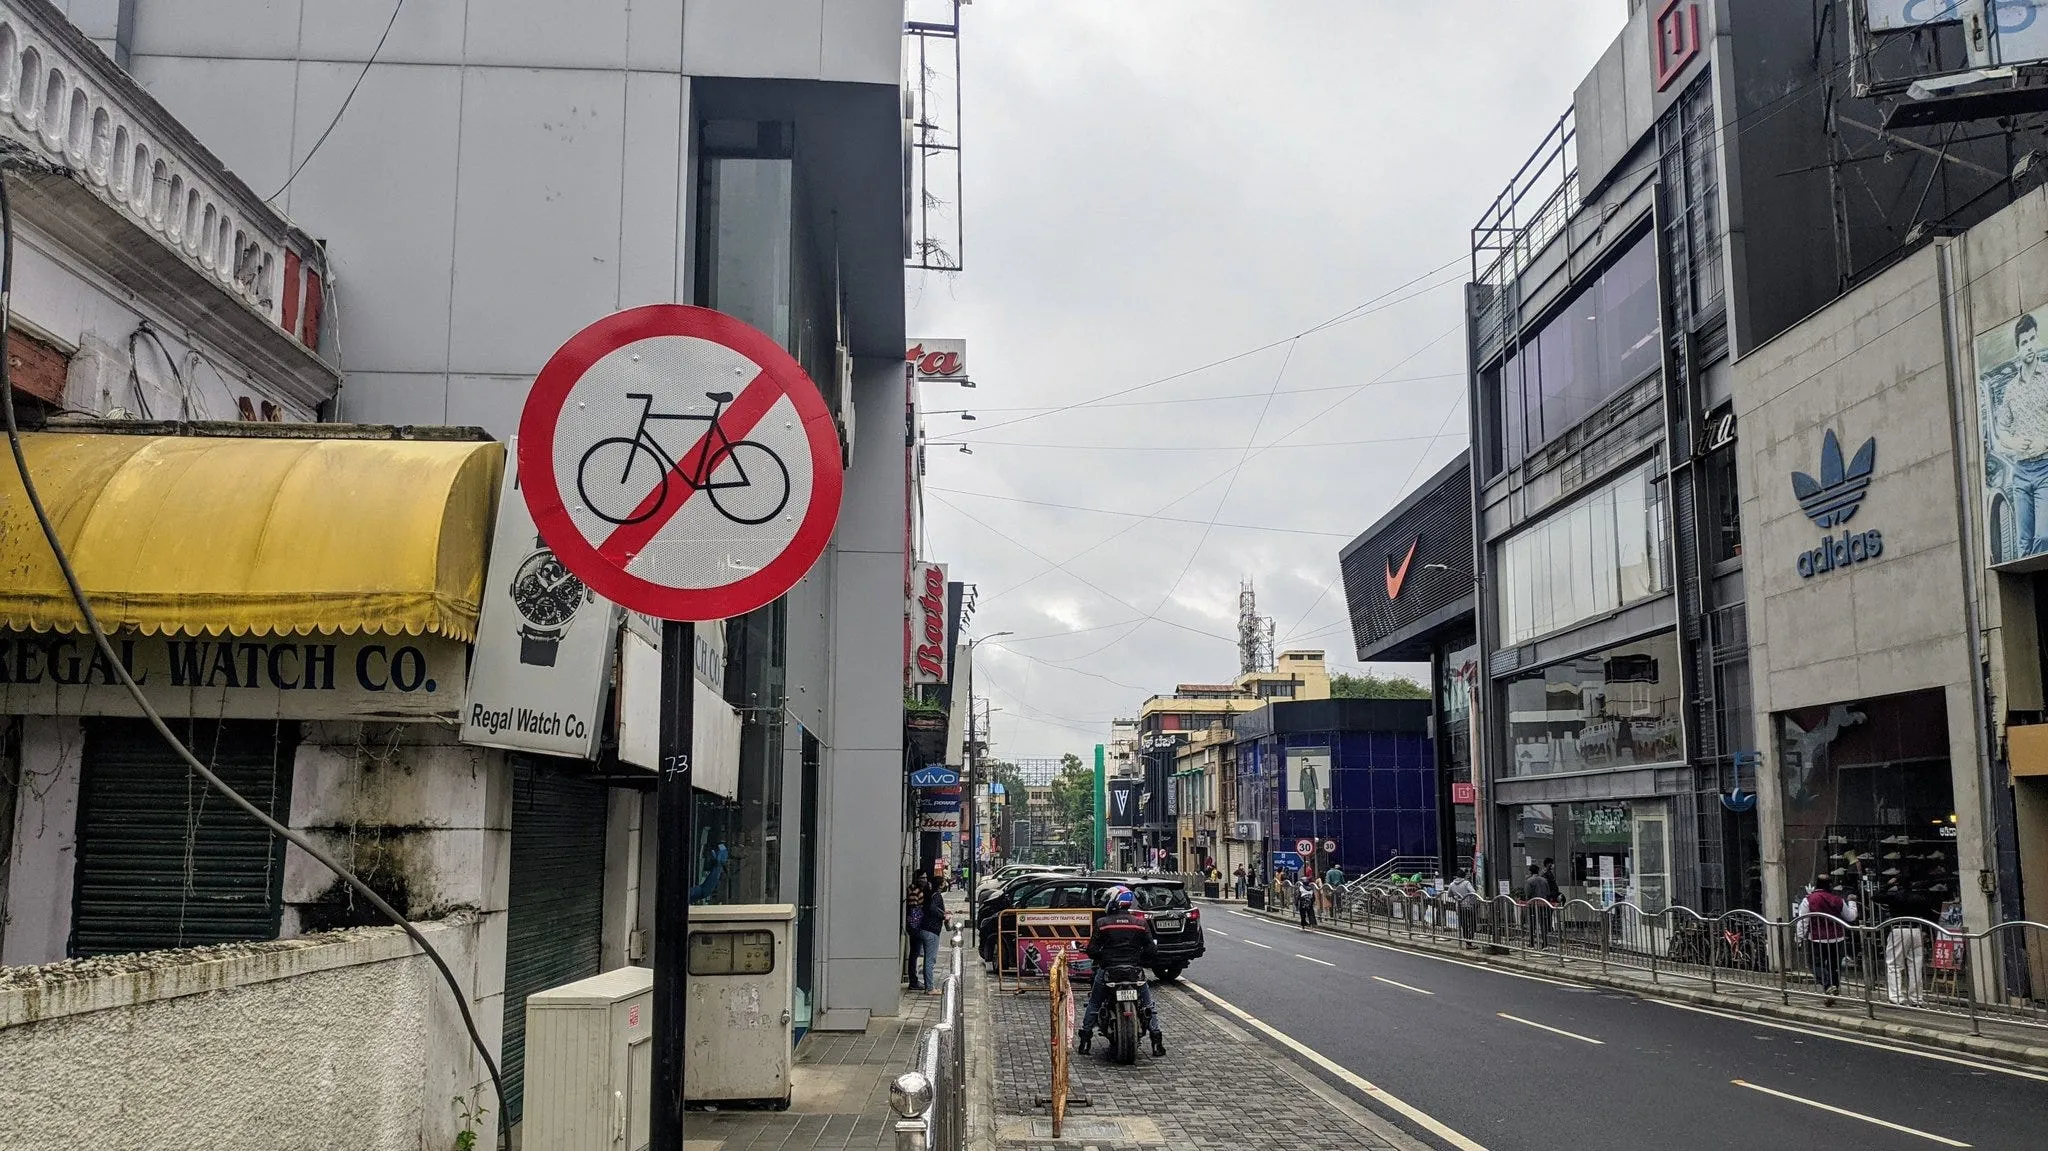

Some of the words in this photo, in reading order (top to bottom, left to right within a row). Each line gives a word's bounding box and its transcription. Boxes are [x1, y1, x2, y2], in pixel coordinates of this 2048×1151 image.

[1797, 528, 1883, 578] adidas
[917, 565, 944, 681] Bata
[167, 640, 336, 691] WATCH
[356, 645, 437, 693] CO.
[471, 702, 513, 731] Regal
[516, 708, 561, 736] Watch
[564, 714, 587, 740] Co.
[664, 755, 688, 782] 73
[915, 772, 955, 784] vivo
[1299, 843, 1310, 851] 30
